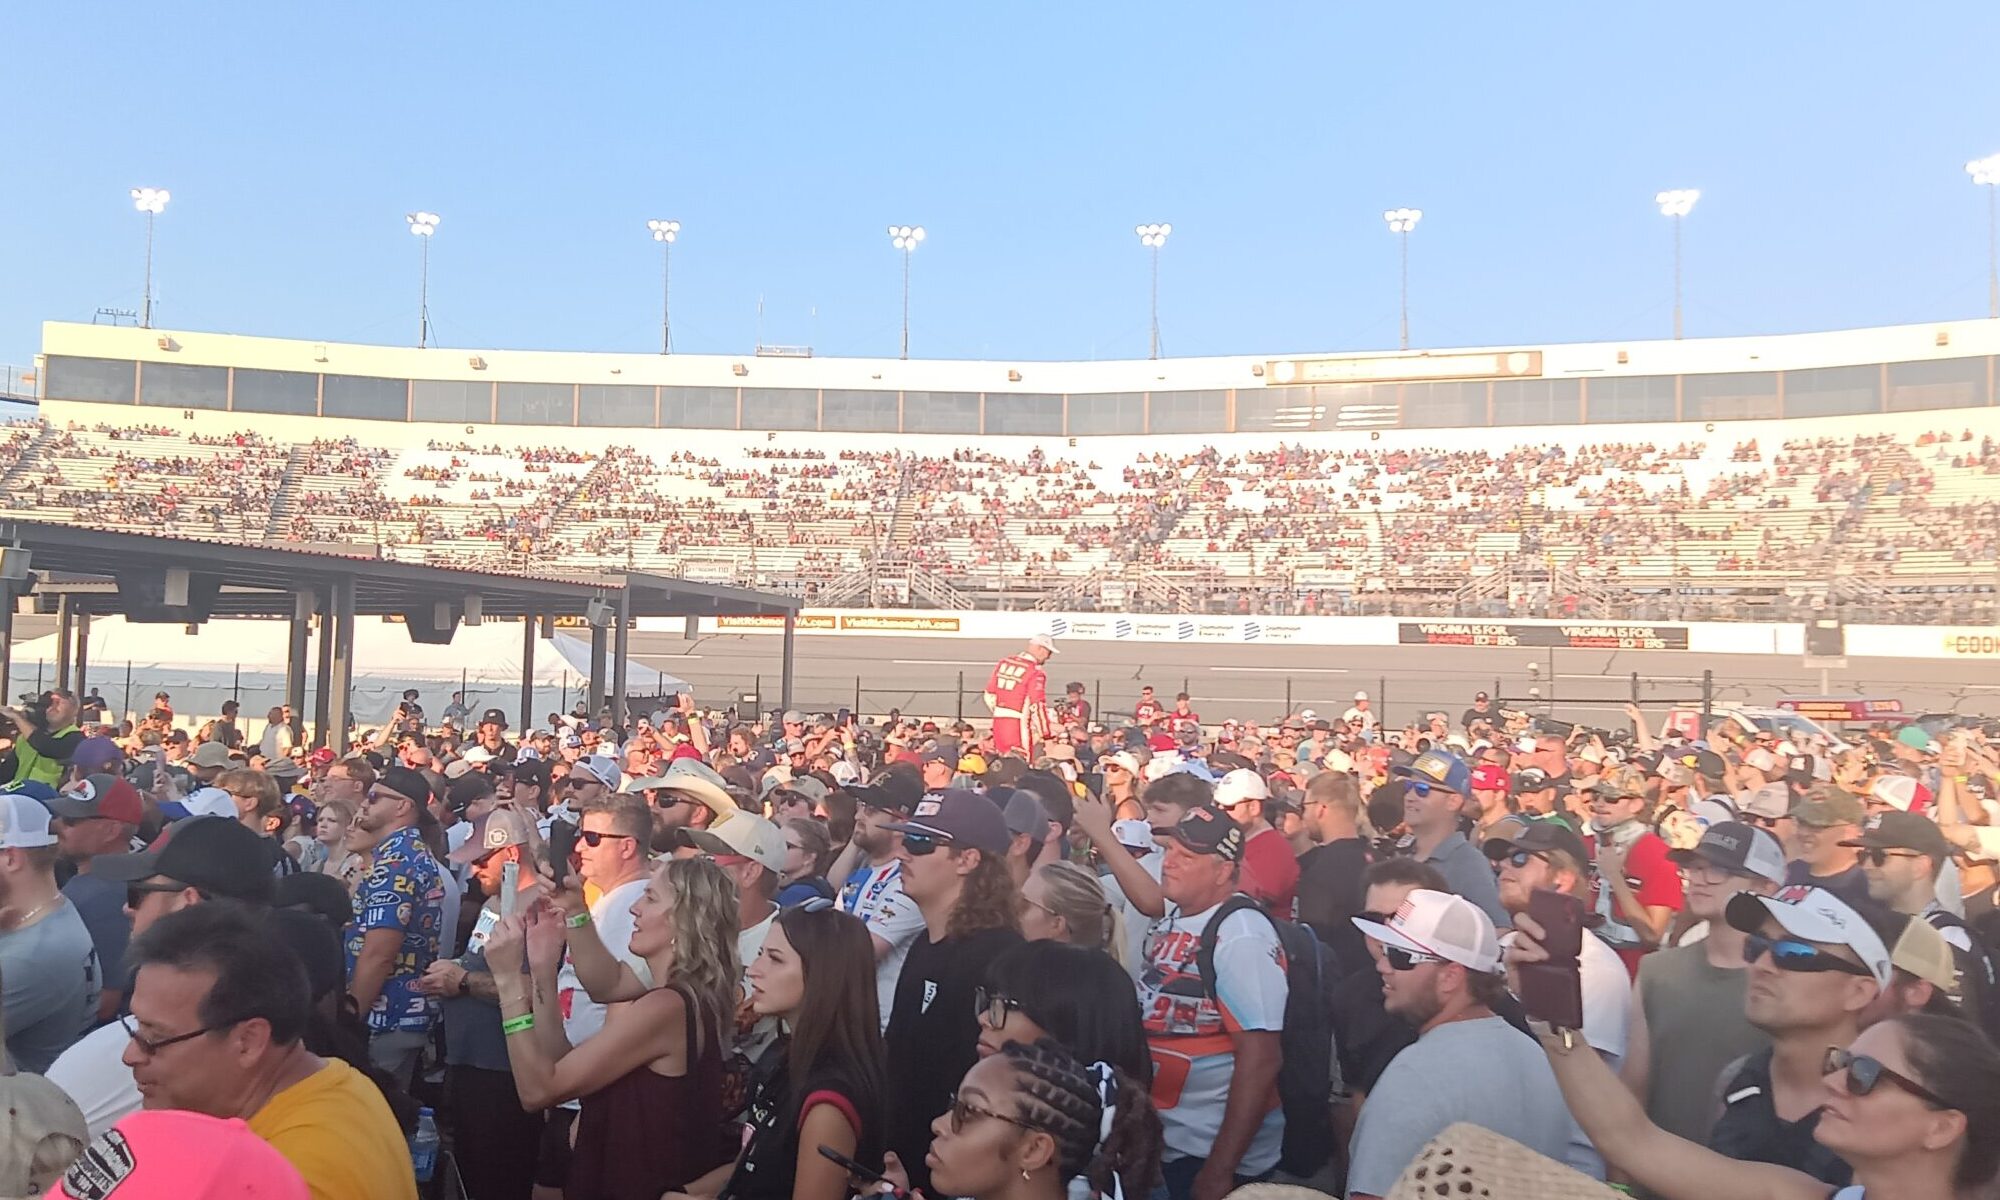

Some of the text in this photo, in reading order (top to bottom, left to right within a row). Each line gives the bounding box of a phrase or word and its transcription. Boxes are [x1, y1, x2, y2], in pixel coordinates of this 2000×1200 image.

[184, 410, 194, 420] H
[465, 425, 474, 435] G
[1705, 423, 1715, 432] C
[768, 432, 777, 441] F
[1371, 431, 1380, 441] D
[1068, 438, 1077, 447] E
[1419, 624, 1508, 635] VIRGINIA IS FOR
[1560, 626, 1656, 638] VIRGINIA IS FOR
[1956, 635, 2000, 654] COO
[393, 874, 415, 895] 24
[406, 997, 426, 1013] 3
